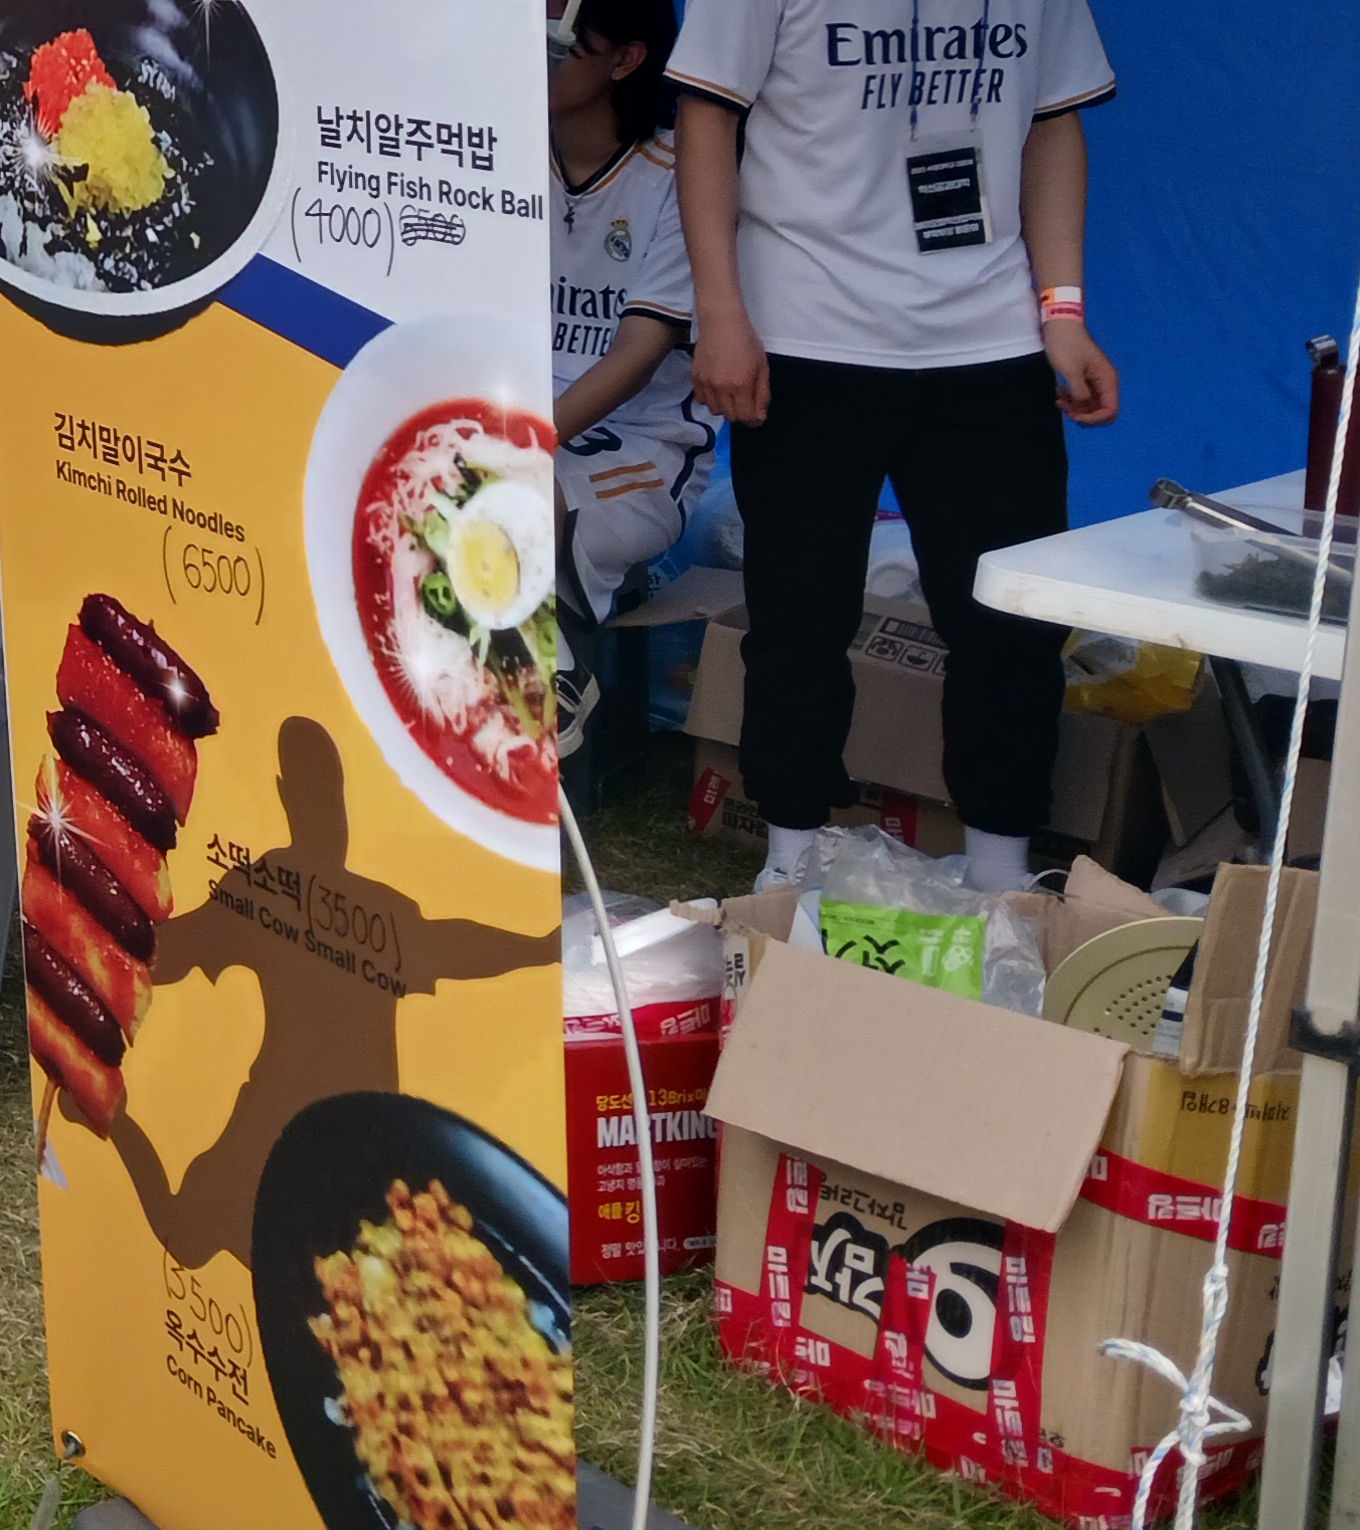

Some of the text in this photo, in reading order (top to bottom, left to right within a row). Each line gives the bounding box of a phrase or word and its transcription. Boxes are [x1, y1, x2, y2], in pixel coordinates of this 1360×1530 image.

[825, 21, 1029, 67] Emirates
[861, 68, 1005, 110] FLY BETTER
[316, 105, 498, 172] 날치알주먹밥
[291, 186, 394, 278] (4000)
[317, 160, 544, 220] Flying Fish Rock Ball
[53, 411, 193, 488] 김치말이국수
[55, 459, 246, 543] Kimchi Rolled Noodles
[162, 523, 266, 627] (6500)
[206, 832, 303, 913] 소떡소떡
[208, 878, 408, 999] Small Cow Small Cow
[307, 873, 403, 975] (3500)
[165, 1309, 250, 1407] 옥수수전
[166, 1354, 278, 1459] Corn Pancake
